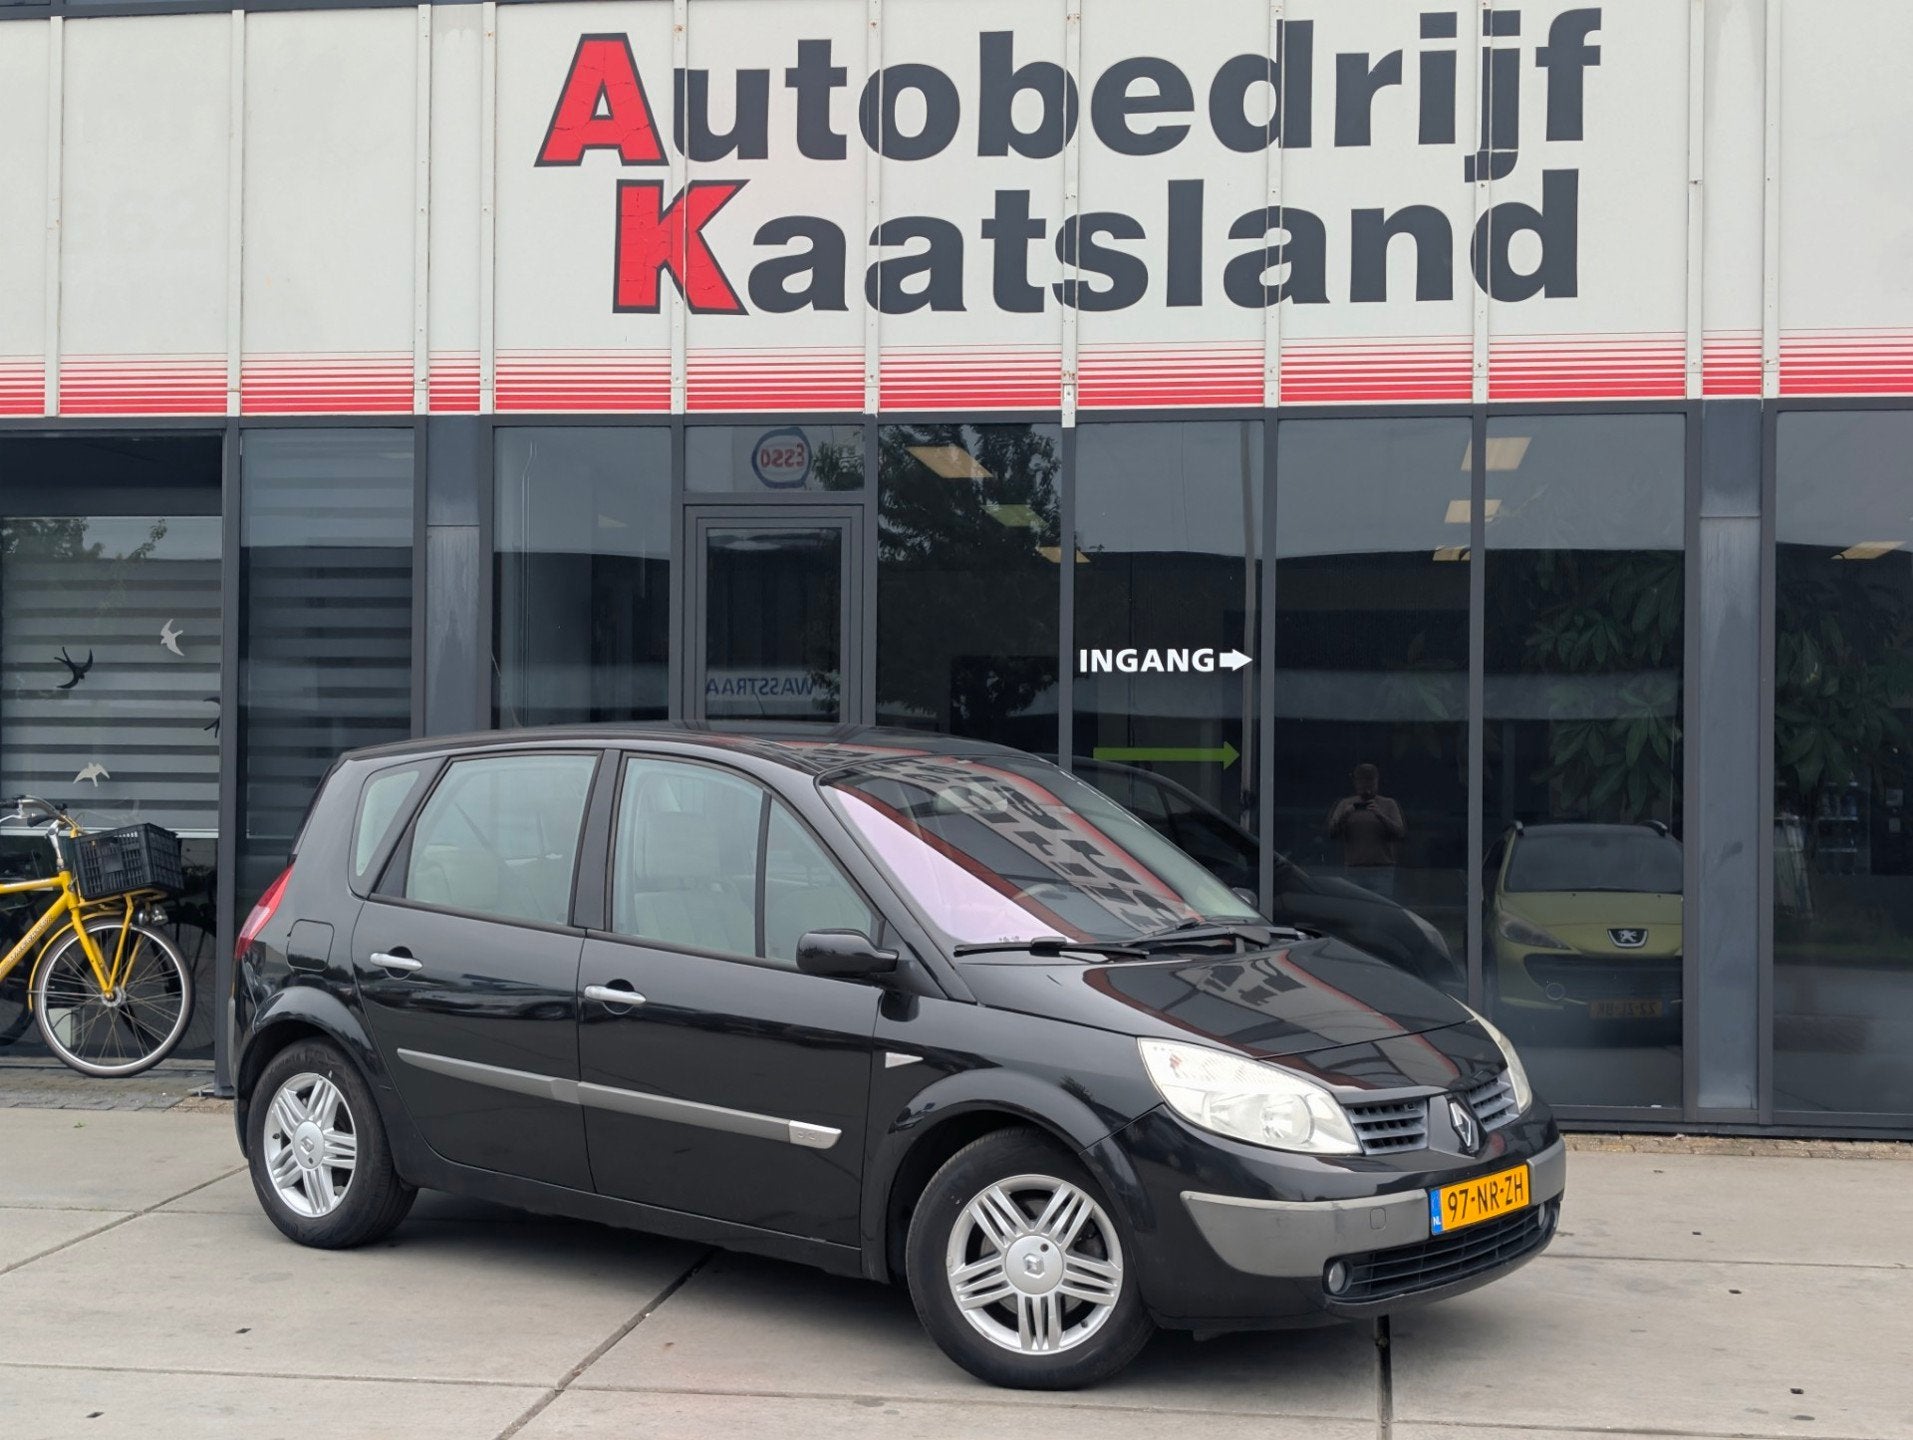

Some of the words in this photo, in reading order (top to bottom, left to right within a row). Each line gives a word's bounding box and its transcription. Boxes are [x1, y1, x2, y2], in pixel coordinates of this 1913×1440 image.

[534, 7, 1602, 183] Autobedrijf
[612, 168, 1580, 315] Kaatsland
[1079, 648, 1215, 672] INGANG
[1432, 1215, 1442, 1226] NL
[1447, 1172, 1524, 1222] 97-NR-ZH
